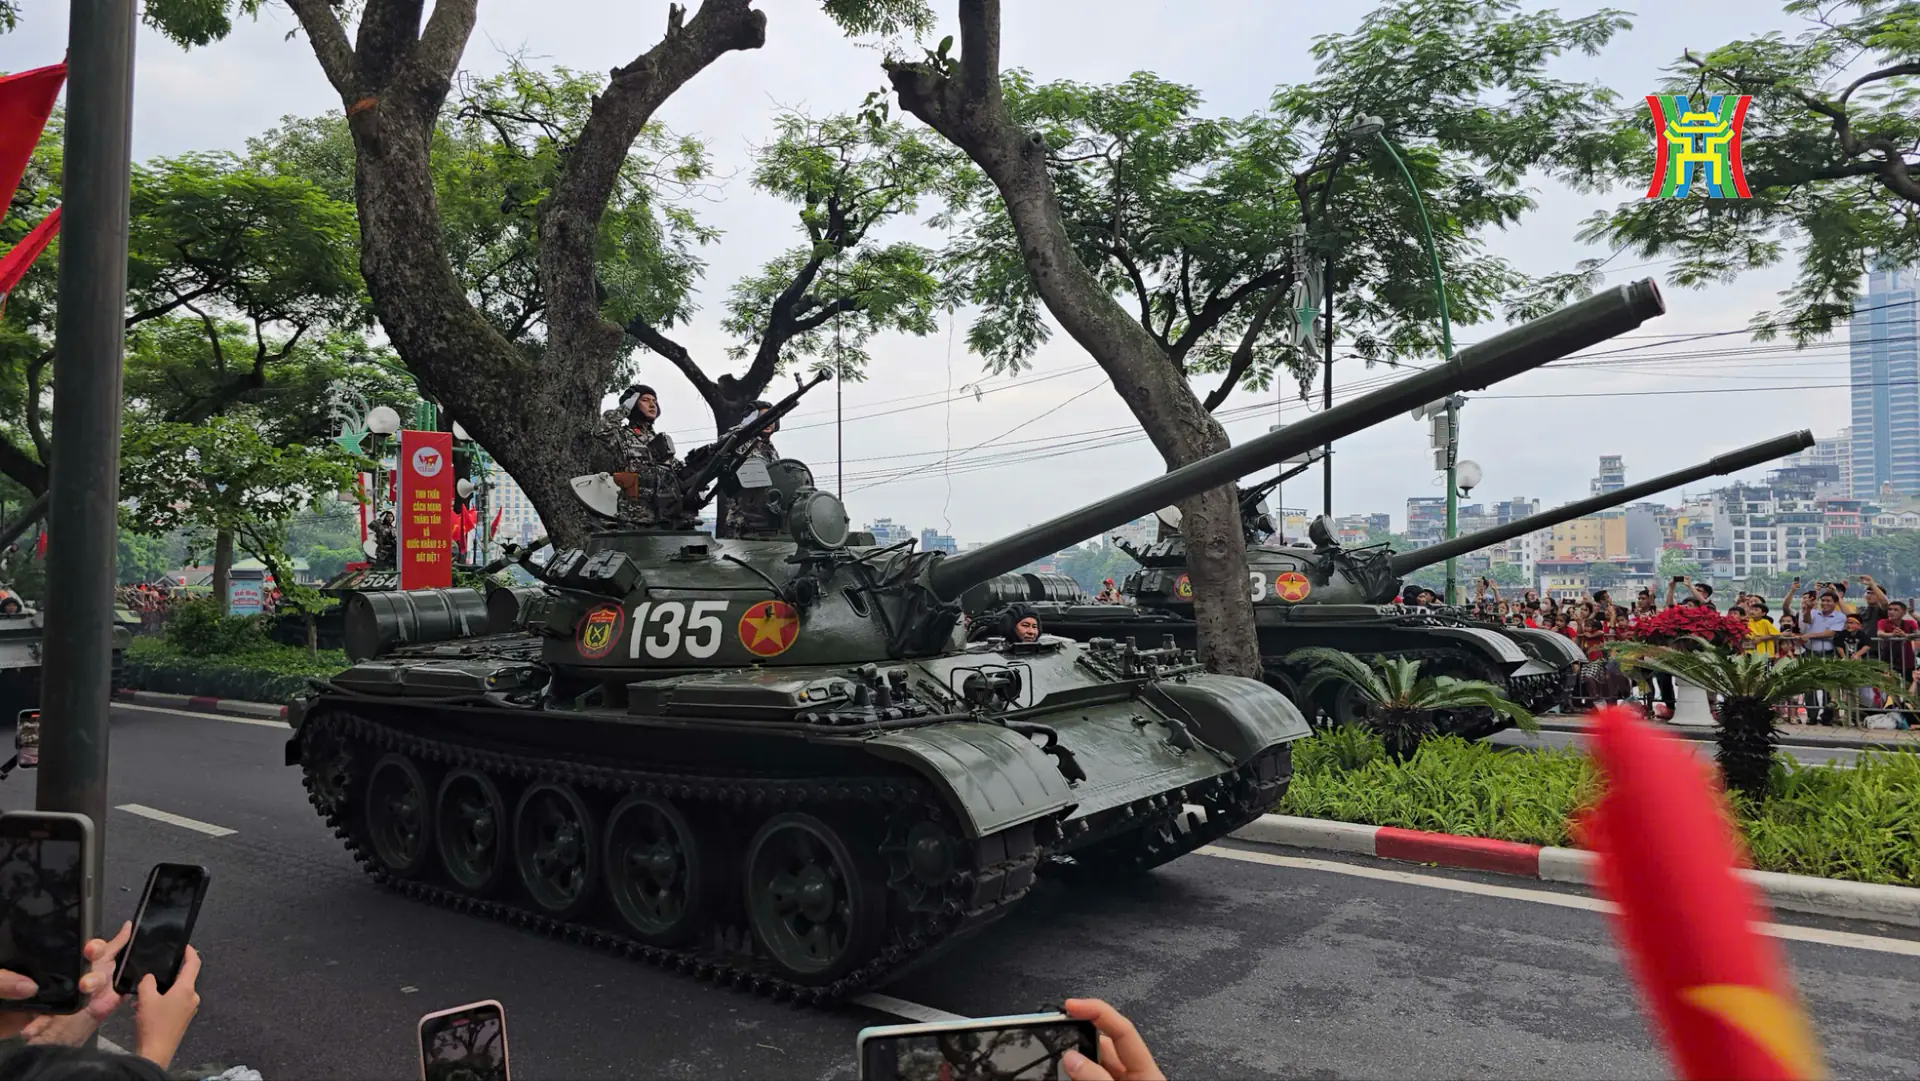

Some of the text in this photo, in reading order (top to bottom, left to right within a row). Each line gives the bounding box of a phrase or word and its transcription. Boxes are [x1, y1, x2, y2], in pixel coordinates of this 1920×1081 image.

[413, 501, 426, 511] CÁCH
[413, 514, 441, 524] THÁNG TÁM
[406, 538, 447, 548] QUỐC KHÁNH 2-9
[360, 574, 399, 588] 564
[629, 600, 730, 659] 135
